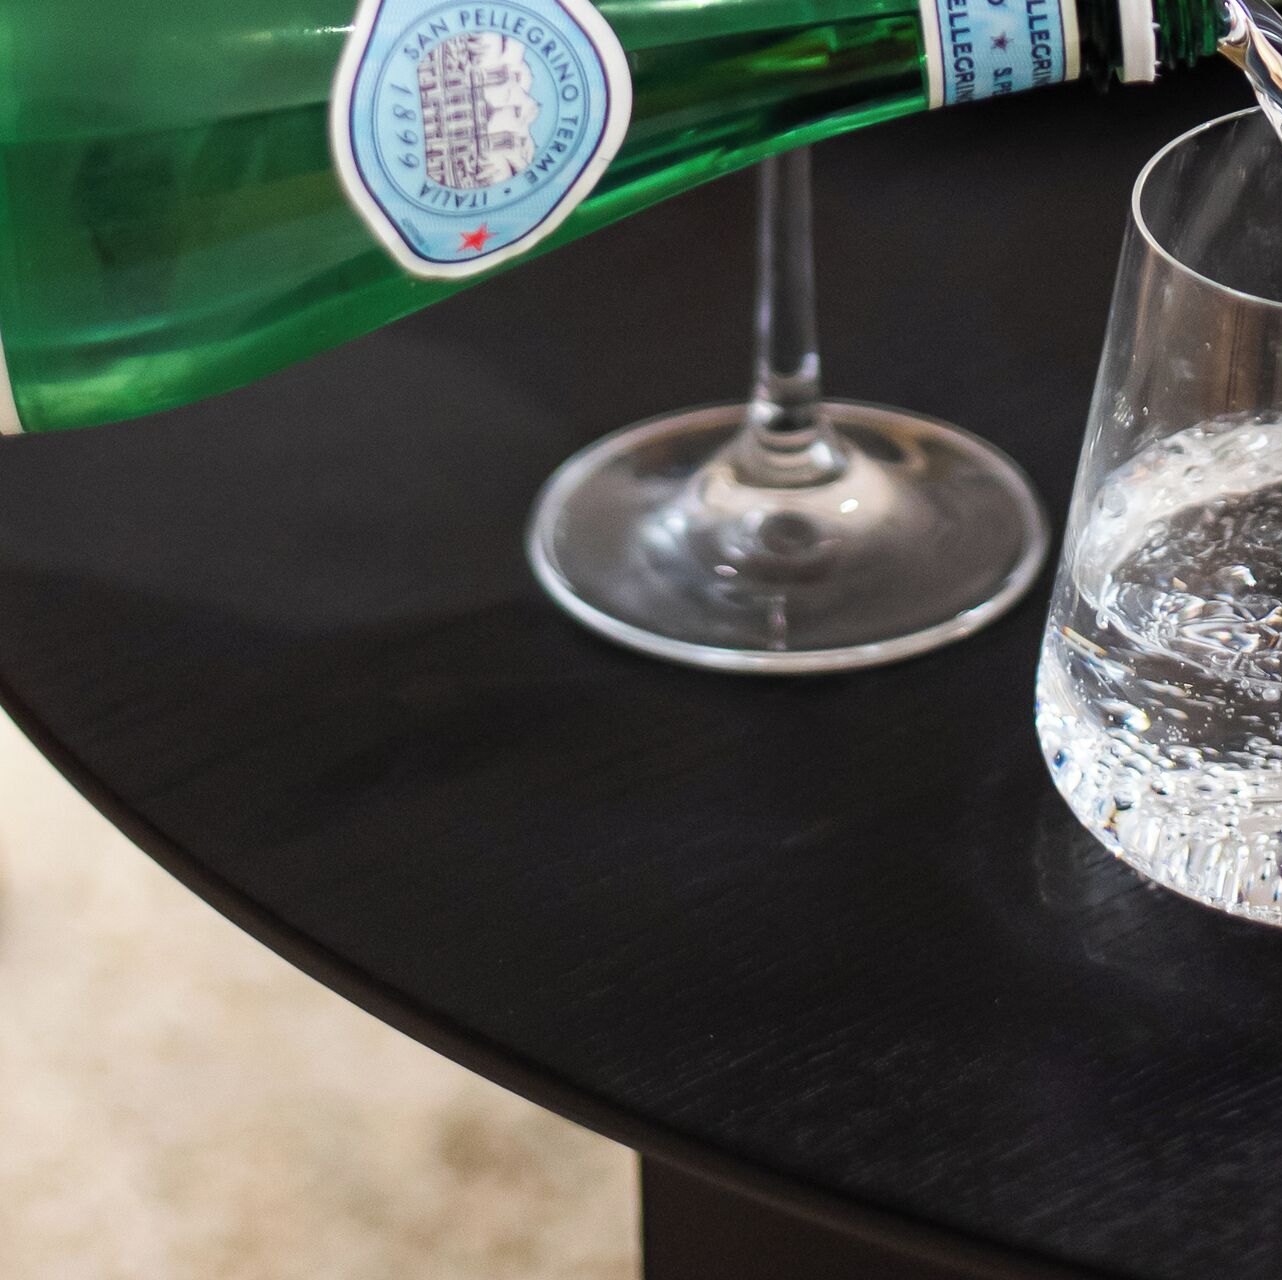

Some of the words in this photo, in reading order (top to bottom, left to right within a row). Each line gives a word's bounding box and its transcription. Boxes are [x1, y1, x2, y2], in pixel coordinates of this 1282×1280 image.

[403, 18, 449, 60] SAN
[460, 8, 579, 102] PELLEGRINO
[391, 83, 420, 169] 1899
[527, 116, 579, 184] TERME
[419, 180, 488, 208] ITALIA
